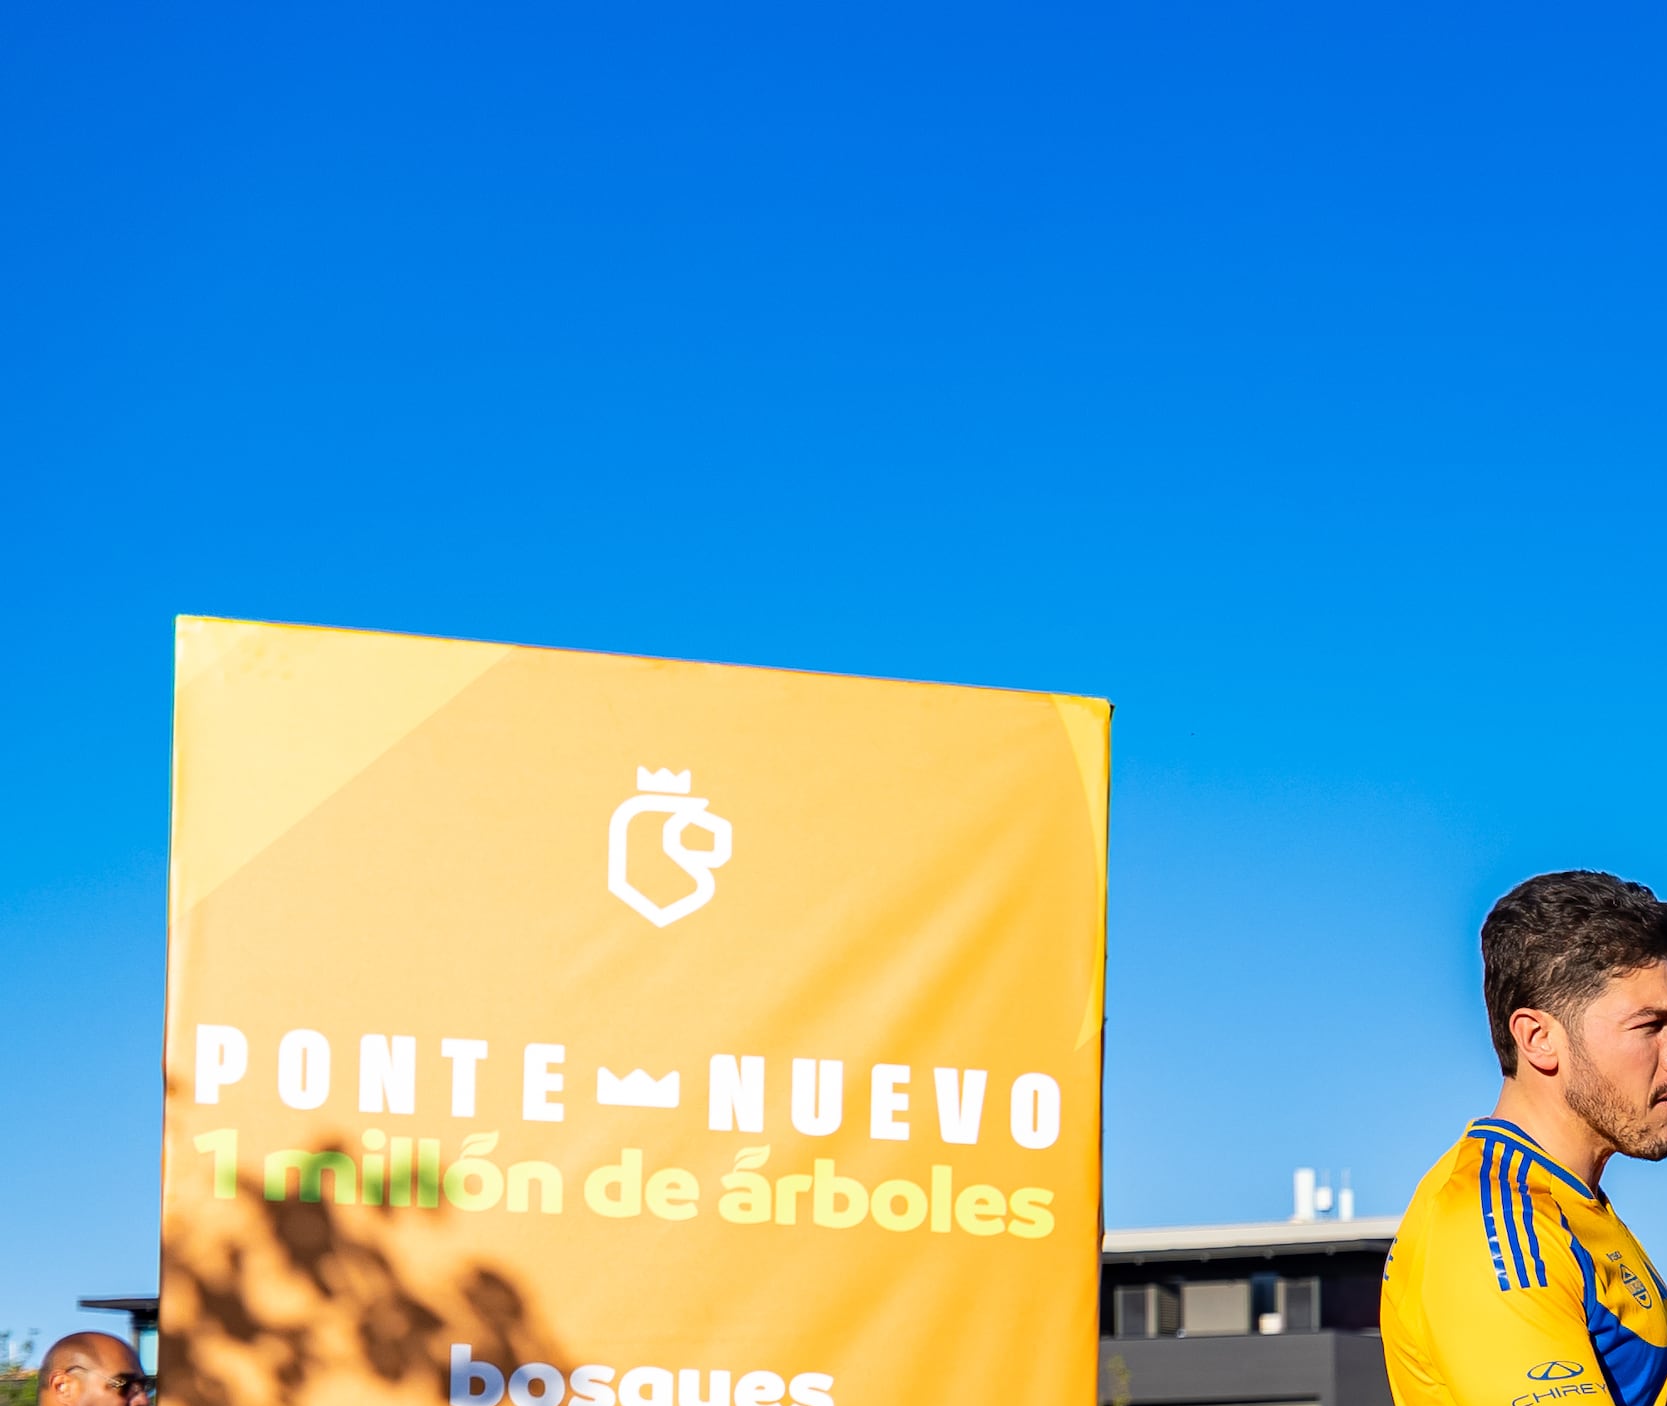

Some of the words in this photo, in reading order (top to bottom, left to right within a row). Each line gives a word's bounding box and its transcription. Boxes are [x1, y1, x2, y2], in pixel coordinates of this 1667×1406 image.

[195, 1024, 565, 1122] PONTE
[709, 1054, 1061, 1149] NUEVO
[194, 1128, 238, 1198] 1
[263, 1130, 562, 1216] millón
[585, 1148, 698, 1221] de
[719, 1143, 1056, 1240] árboles
